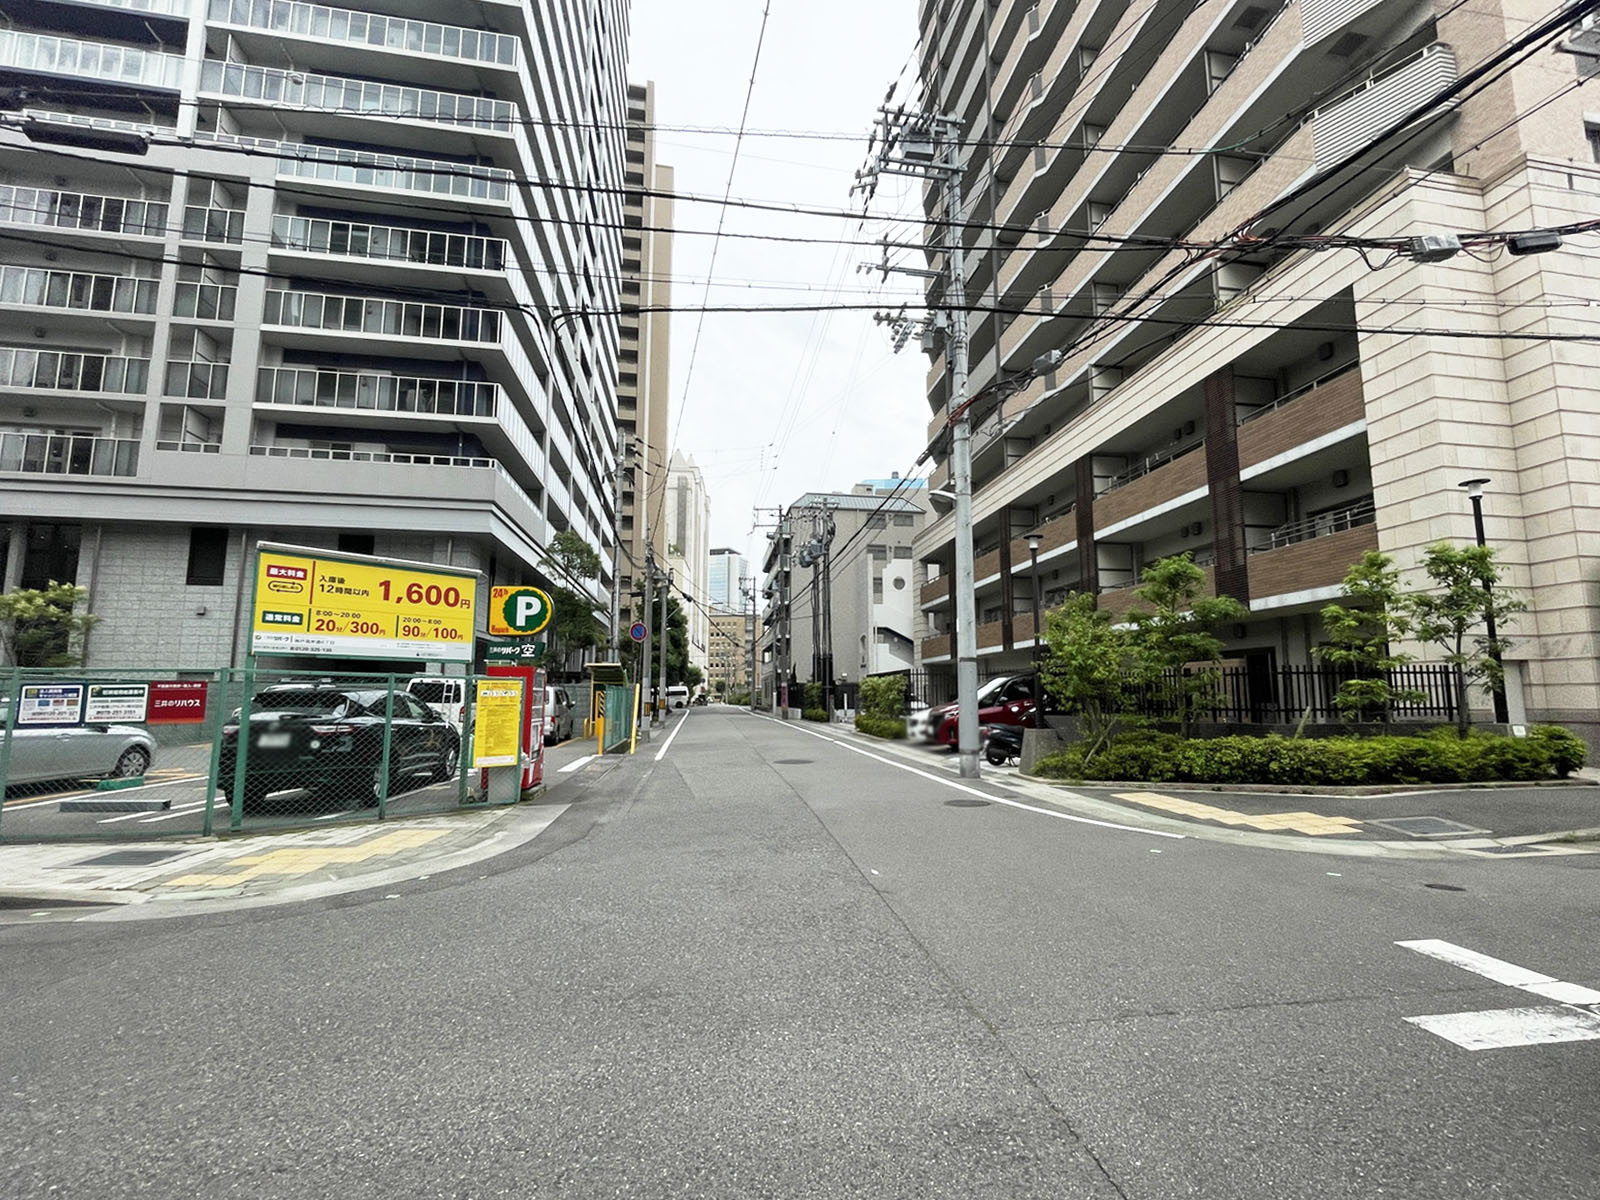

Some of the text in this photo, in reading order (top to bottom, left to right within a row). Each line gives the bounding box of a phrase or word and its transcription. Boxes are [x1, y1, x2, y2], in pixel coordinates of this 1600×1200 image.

[269, 567, 305, 578] 最大料金
[319, 575, 346, 584] 入庫後
[319, 584, 369, 597] 12時間以内
[378, 580, 471, 609] 1,600円
[516, 596, 542, 627] P
[264, 613, 301, 624] 通常料金
[521, 643, 535, 657] 空
[154, 699, 201, 708] 三井のリハウス
